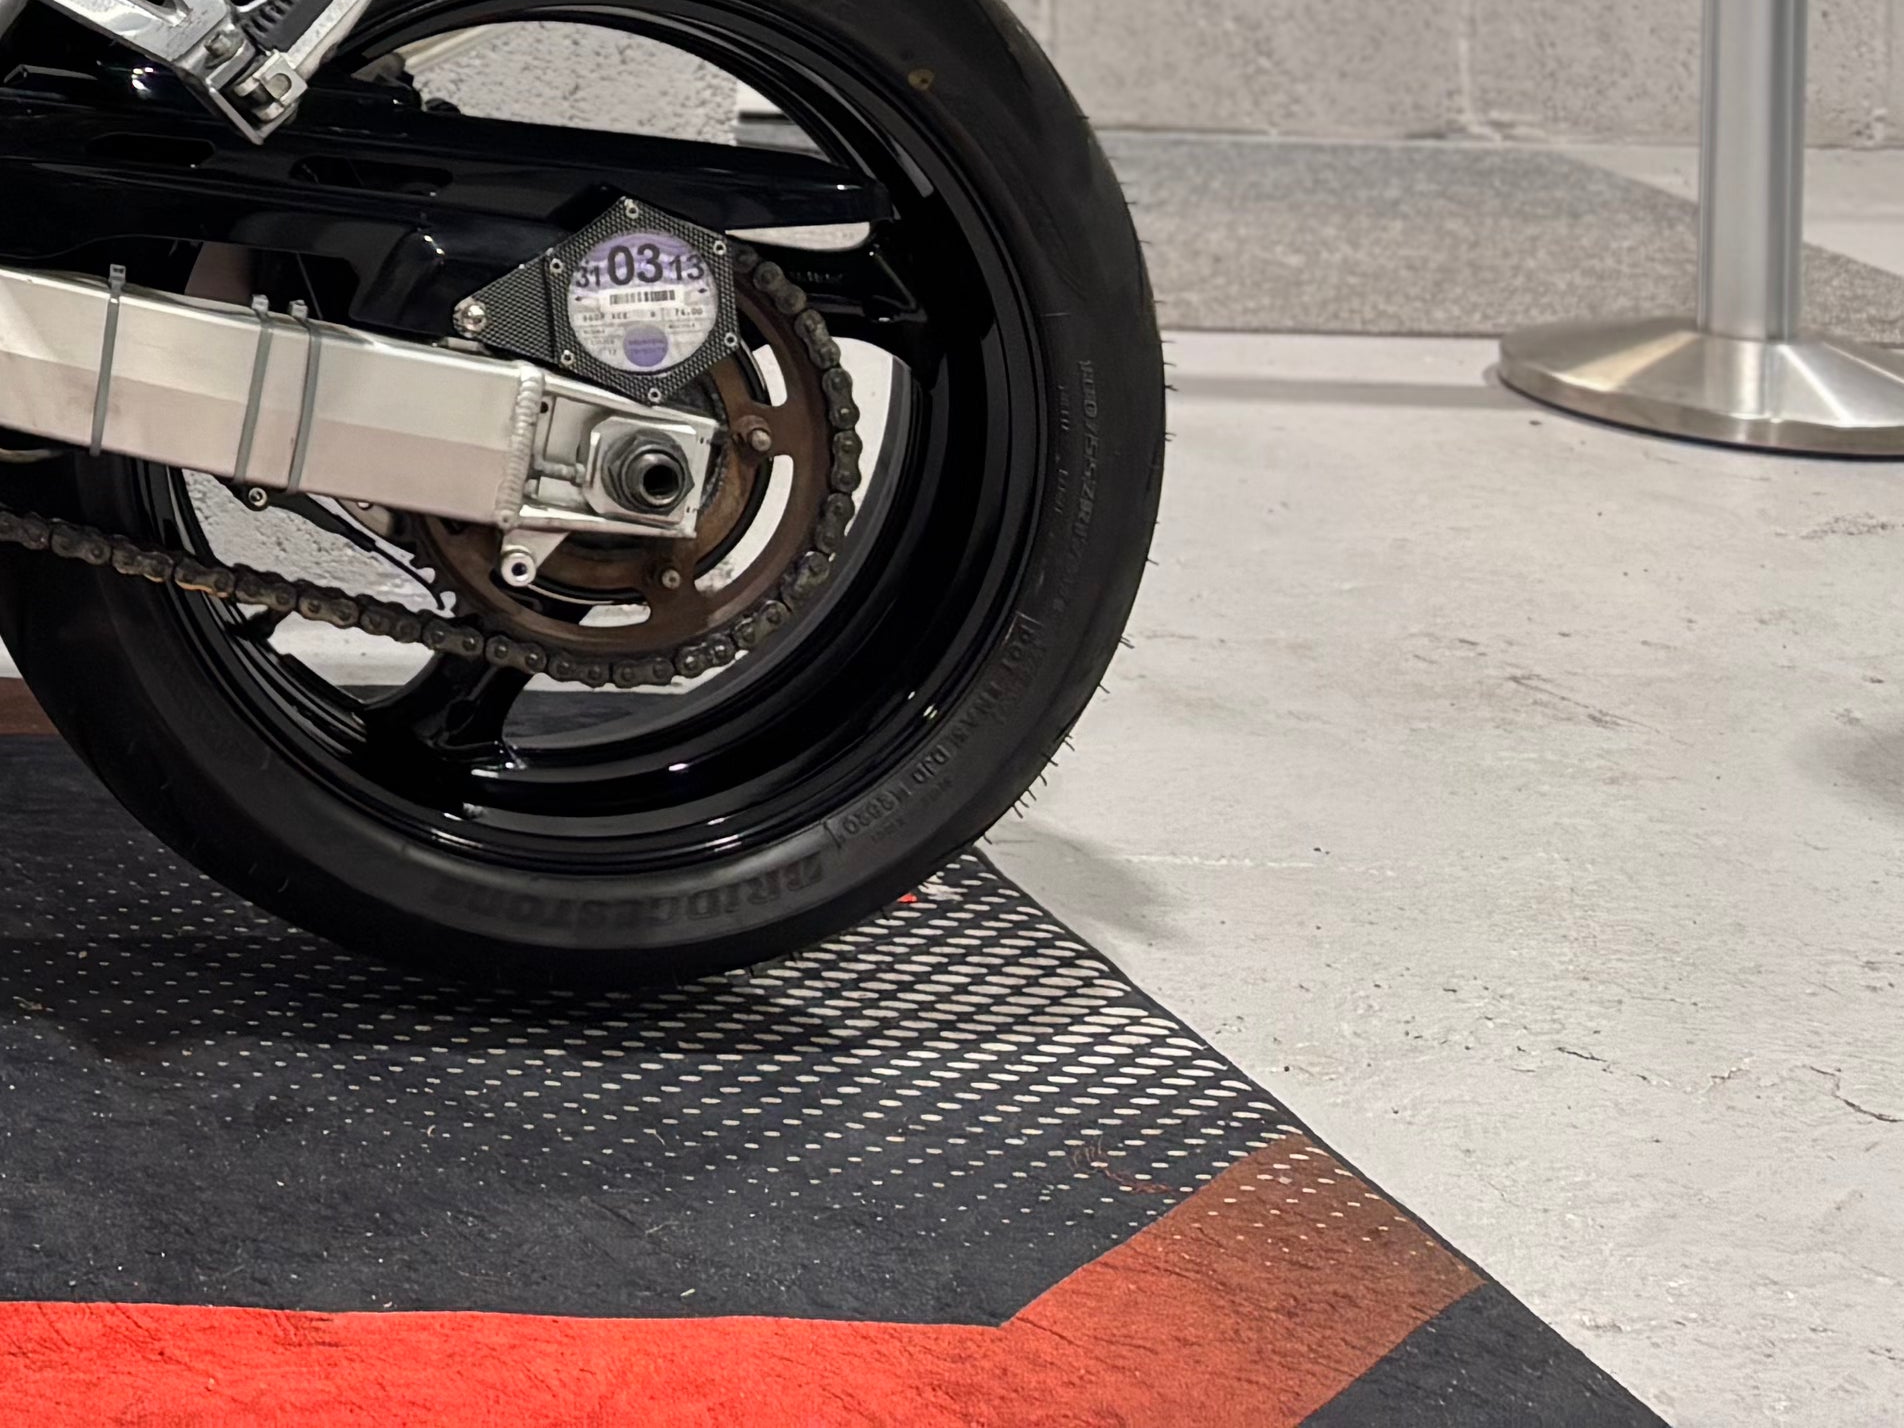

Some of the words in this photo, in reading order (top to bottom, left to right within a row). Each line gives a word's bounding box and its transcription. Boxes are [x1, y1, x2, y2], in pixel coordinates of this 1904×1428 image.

[575, 264, 601, 289] 31
[607, 243, 664, 286] 03
[668, 254, 705, 281] 13
